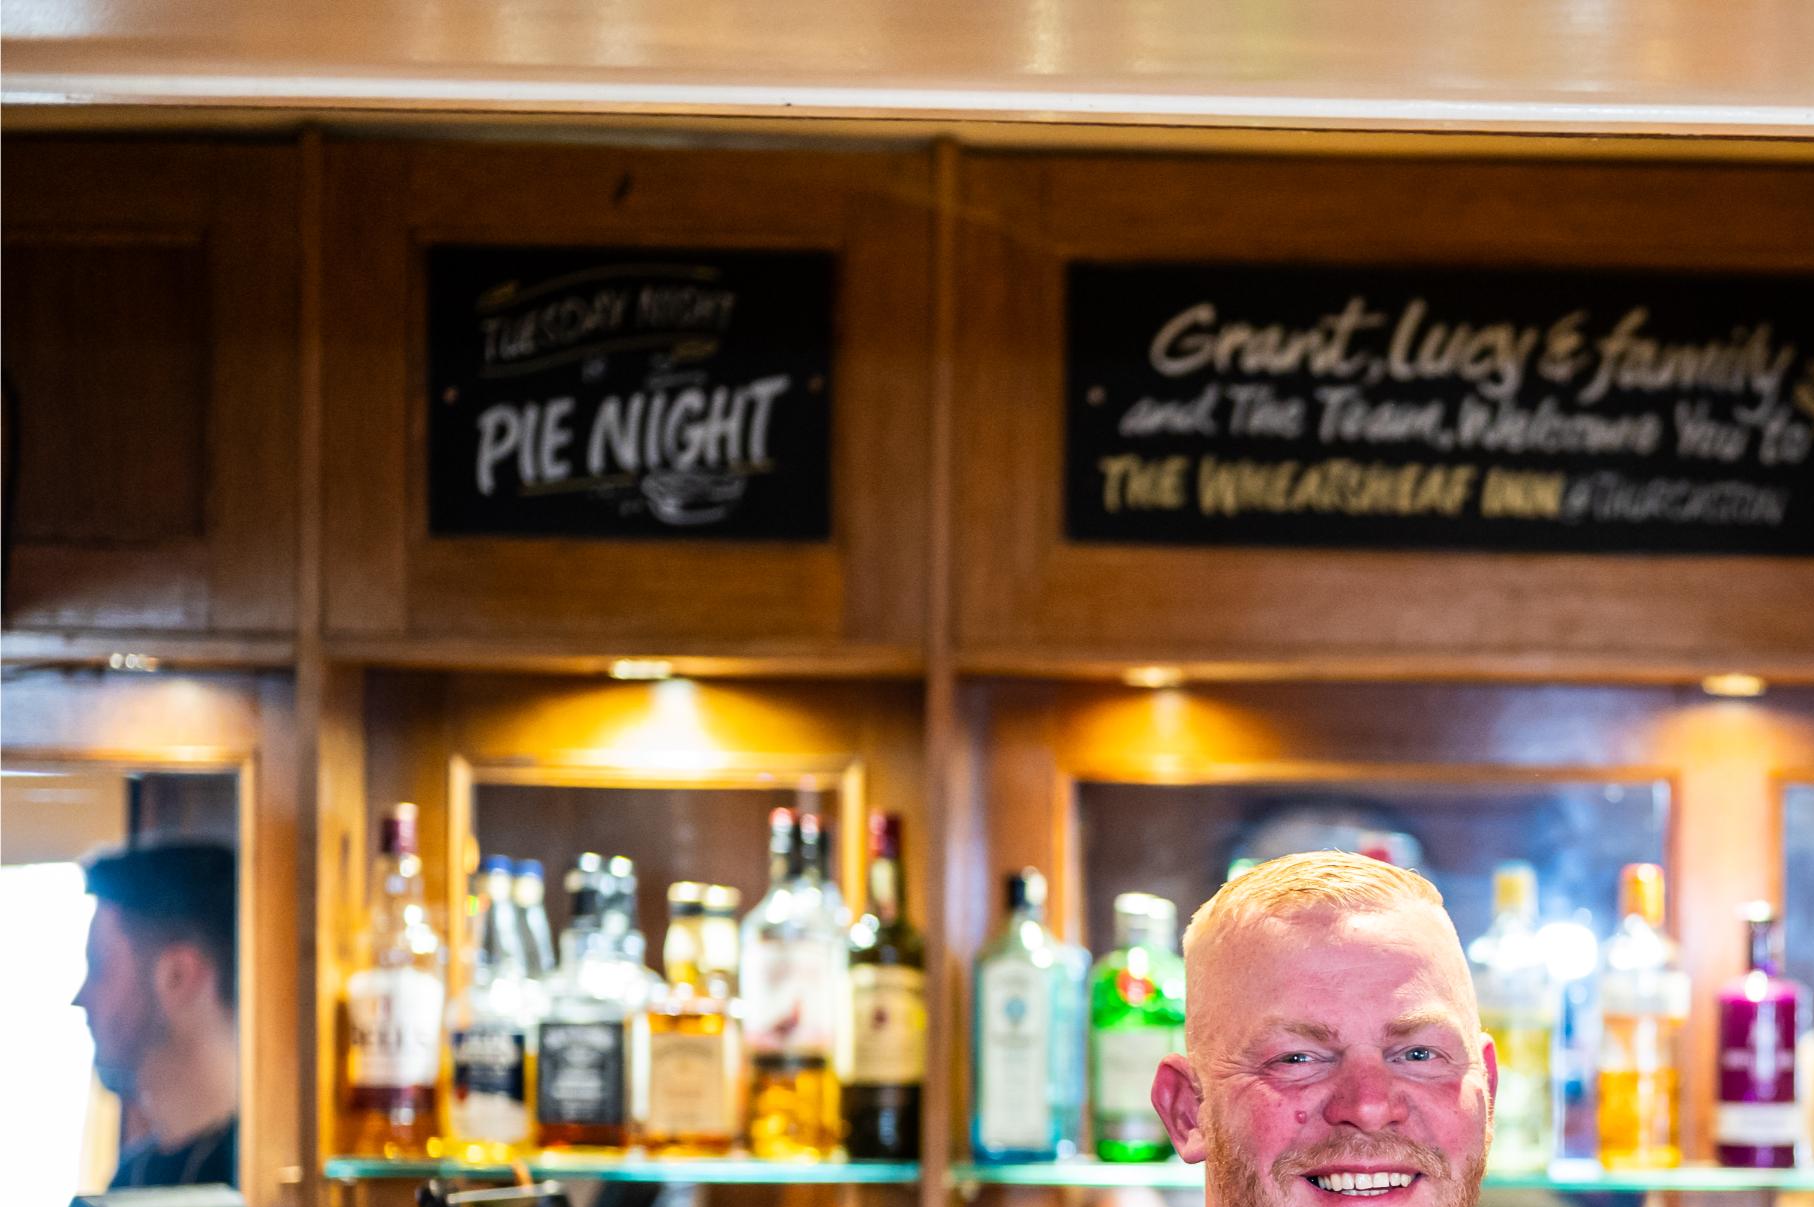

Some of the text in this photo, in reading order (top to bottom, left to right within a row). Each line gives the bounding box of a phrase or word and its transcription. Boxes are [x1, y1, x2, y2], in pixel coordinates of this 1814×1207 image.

[1116, 382, 1219, 438] and
[1576, 305, 1798, 424] family
[475, 373, 792, 496] PIE NIGHT
[1098, 452, 1189, 516] THE
[1196, 452, 1478, 520] WHEATSHEAF
[1479, 468, 1566, 521] INN
